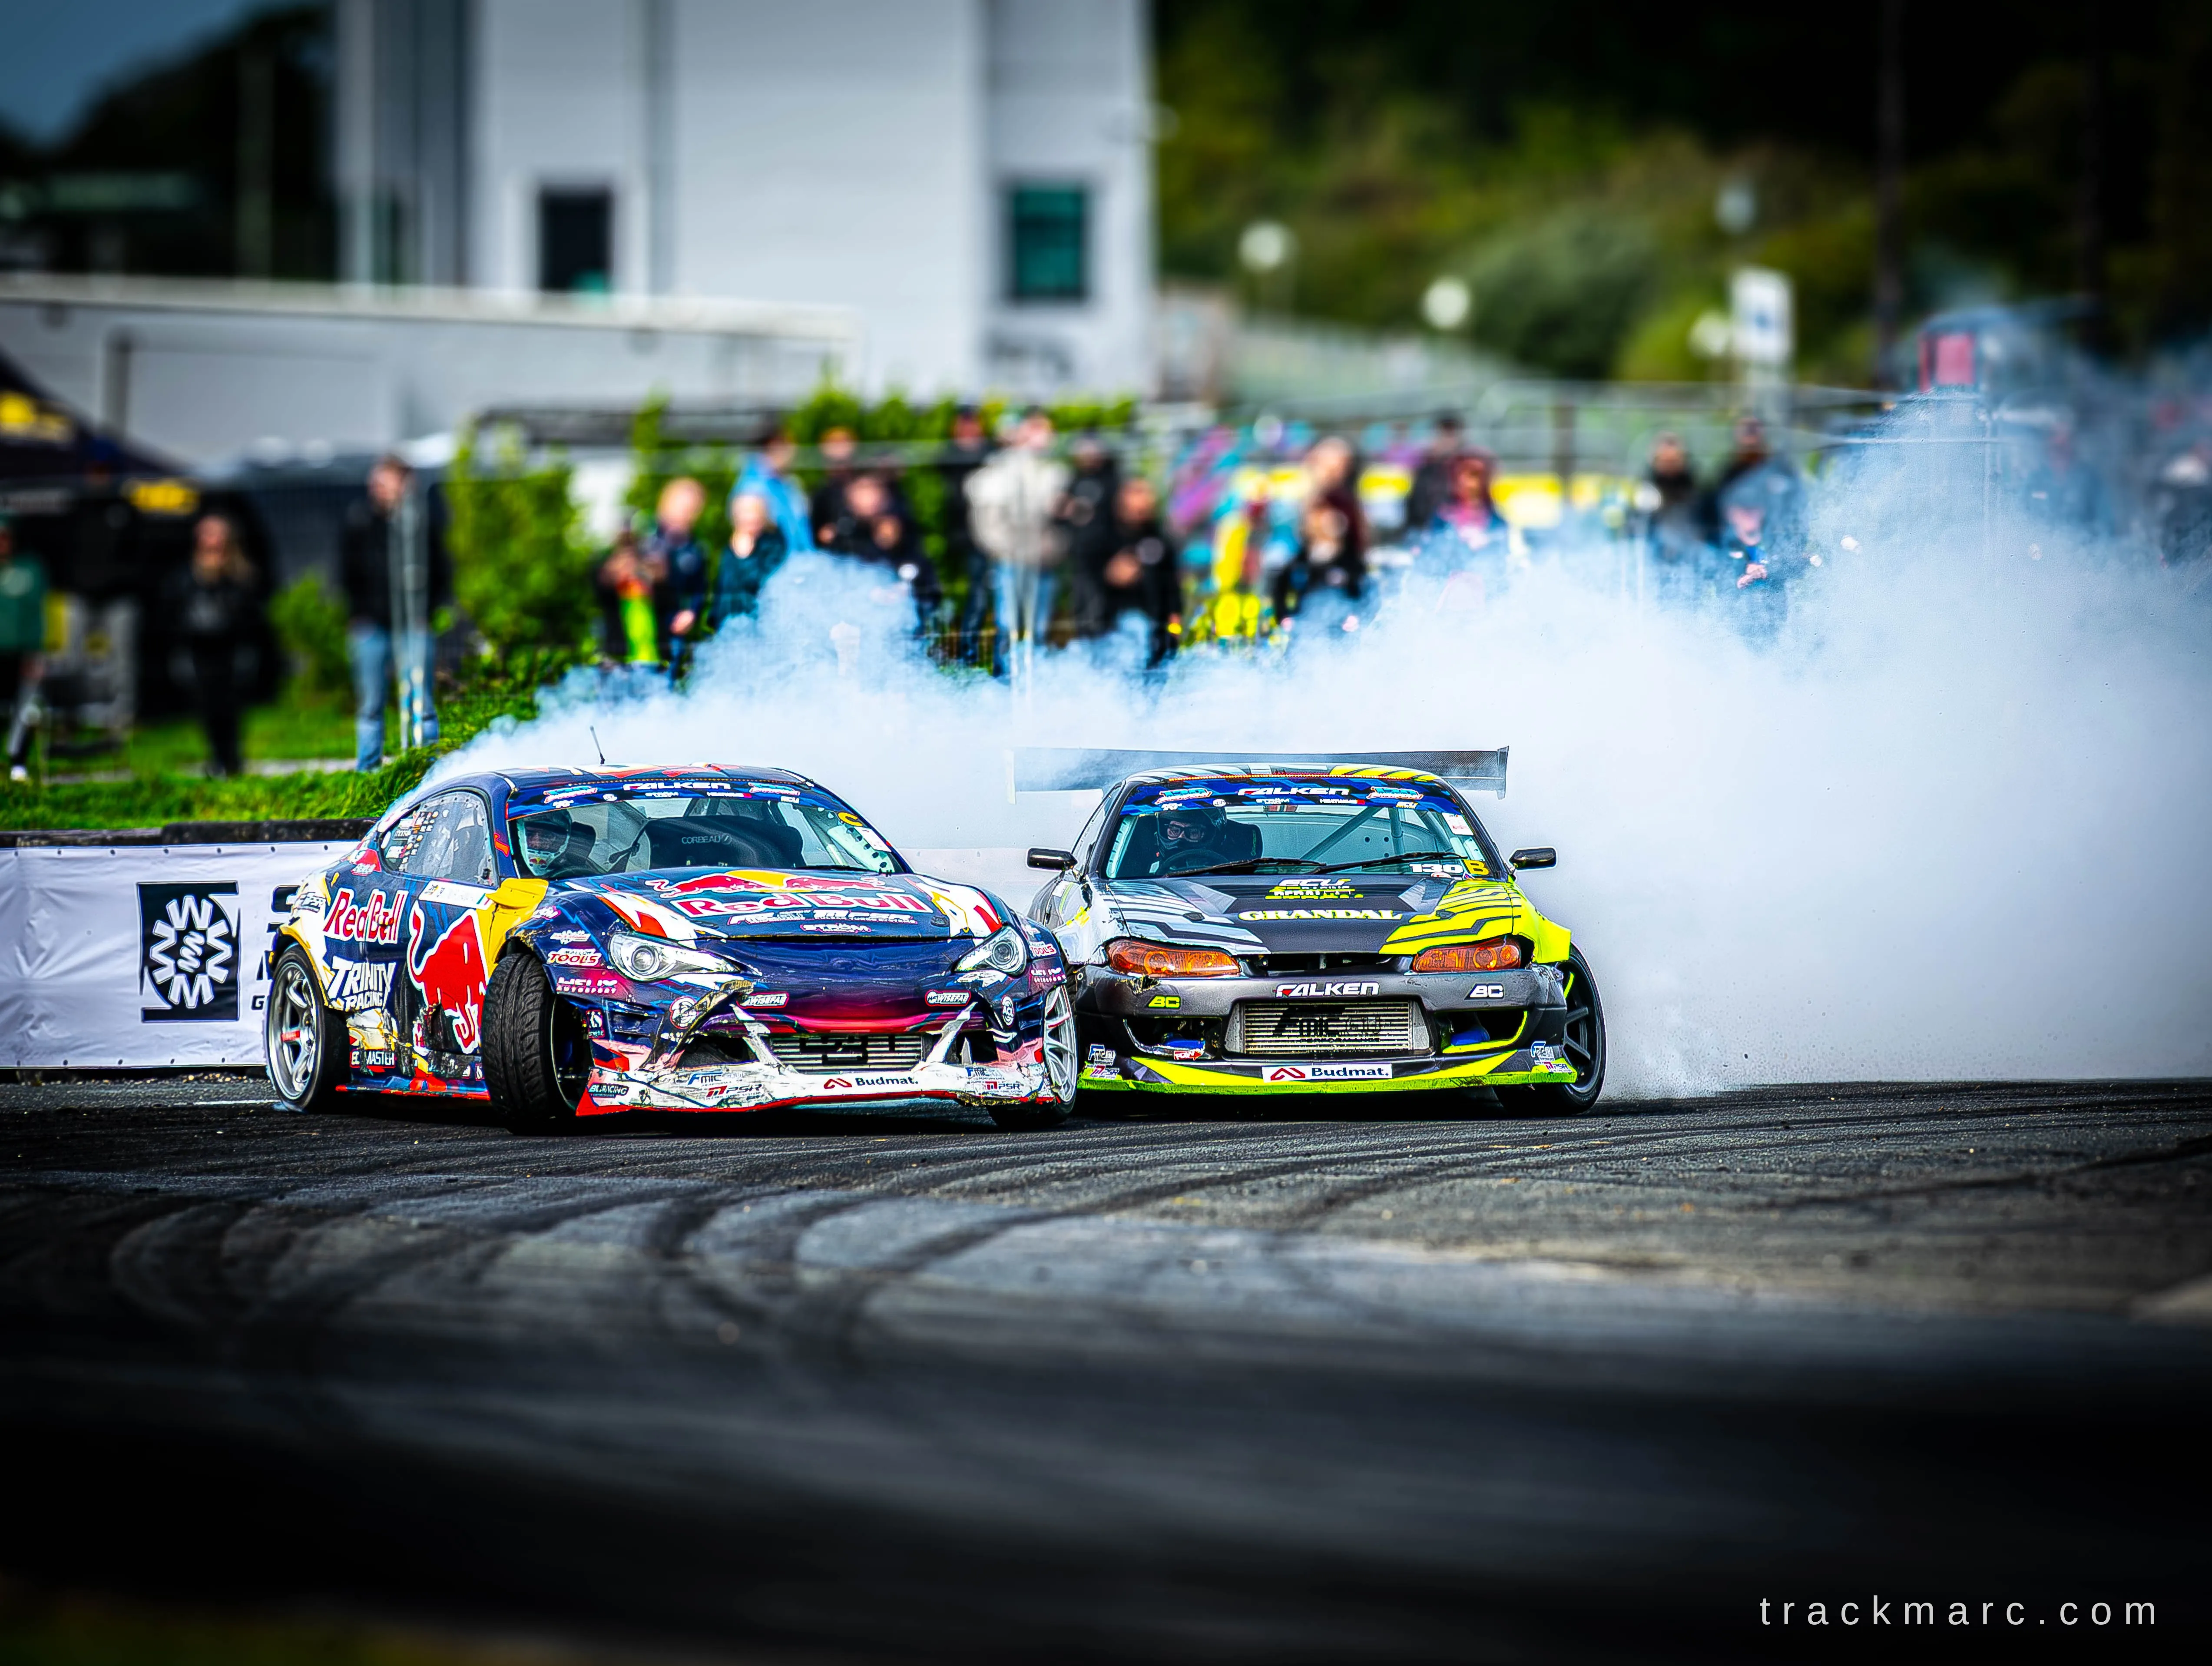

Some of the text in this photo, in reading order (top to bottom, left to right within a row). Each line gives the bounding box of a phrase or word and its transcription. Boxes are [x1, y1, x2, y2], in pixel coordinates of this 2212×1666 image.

[623, 782, 731, 790] FALKEN
[1238, 788, 1350, 796] FALKEN
[838, 812, 863, 826] C
[682, 835, 721, 844] CORBEAU
[1409, 863, 1464, 873] 130
[1463, 859, 1489, 875] B
[673, 894, 806, 916] Red
[801, 893, 930, 913] Bull
[323, 890, 377, 938] Red
[1238, 909, 1403, 921] GRANDAL
[1030, 945, 1055, 955] TOOLS
[550, 953, 599, 964] TOOLS
[328, 955, 396, 1010] TRINITY
[1274, 983, 1380, 997] FALKEN
[1470, 985, 1503, 998] BC
[343, 991, 383, 1012] RACING
[749, 994, 787, 1005] WISEFAB
[937, 993, 969, 1004] WISEFAB
[1148, 996, 1180, 1008] BC
[351, 1051, 394, 1066] ECMASTER
[1311, 1067, 1389, 1077] Budmat.
[688, 1072, 723, 1085] FMIC
[855, 1076, 918, 1086] Budmat.
[726, 1084, 762, 1094] PSR
